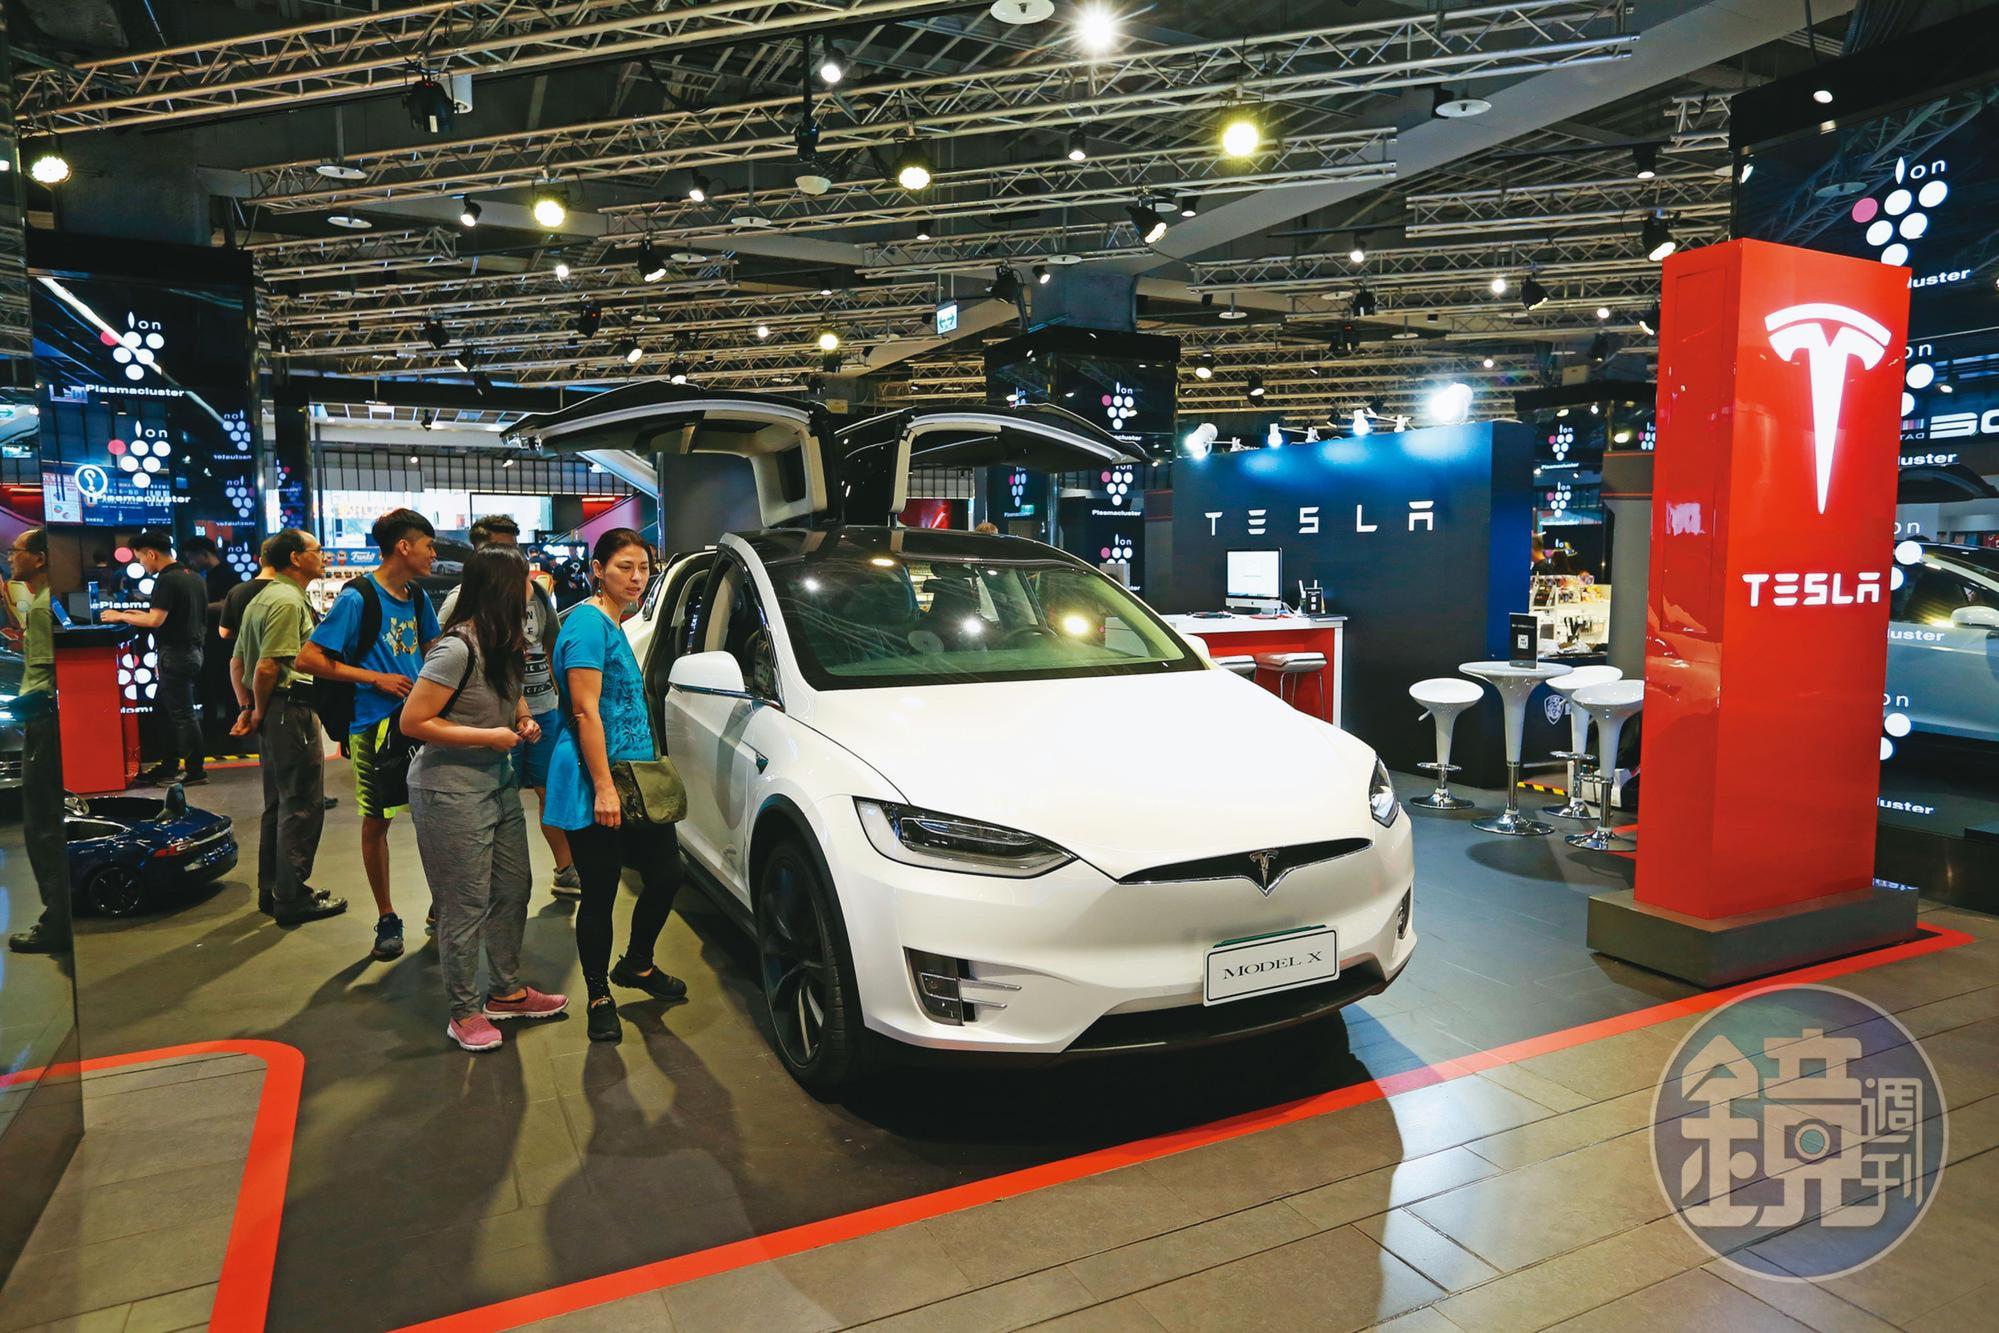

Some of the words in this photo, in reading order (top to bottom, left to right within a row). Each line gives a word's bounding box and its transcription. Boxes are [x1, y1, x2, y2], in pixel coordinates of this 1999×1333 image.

[85, 384, 185, 398] Plasmacluster
[1092, 509, 1142, 517] Plasmacluster
[1204, 500, 1434, 536] TESLA
[1741, 572, 1881, 607] TESLA
[1223, 957, 1302, 980] MODEL
[1308, 951, 1323, 963] X
